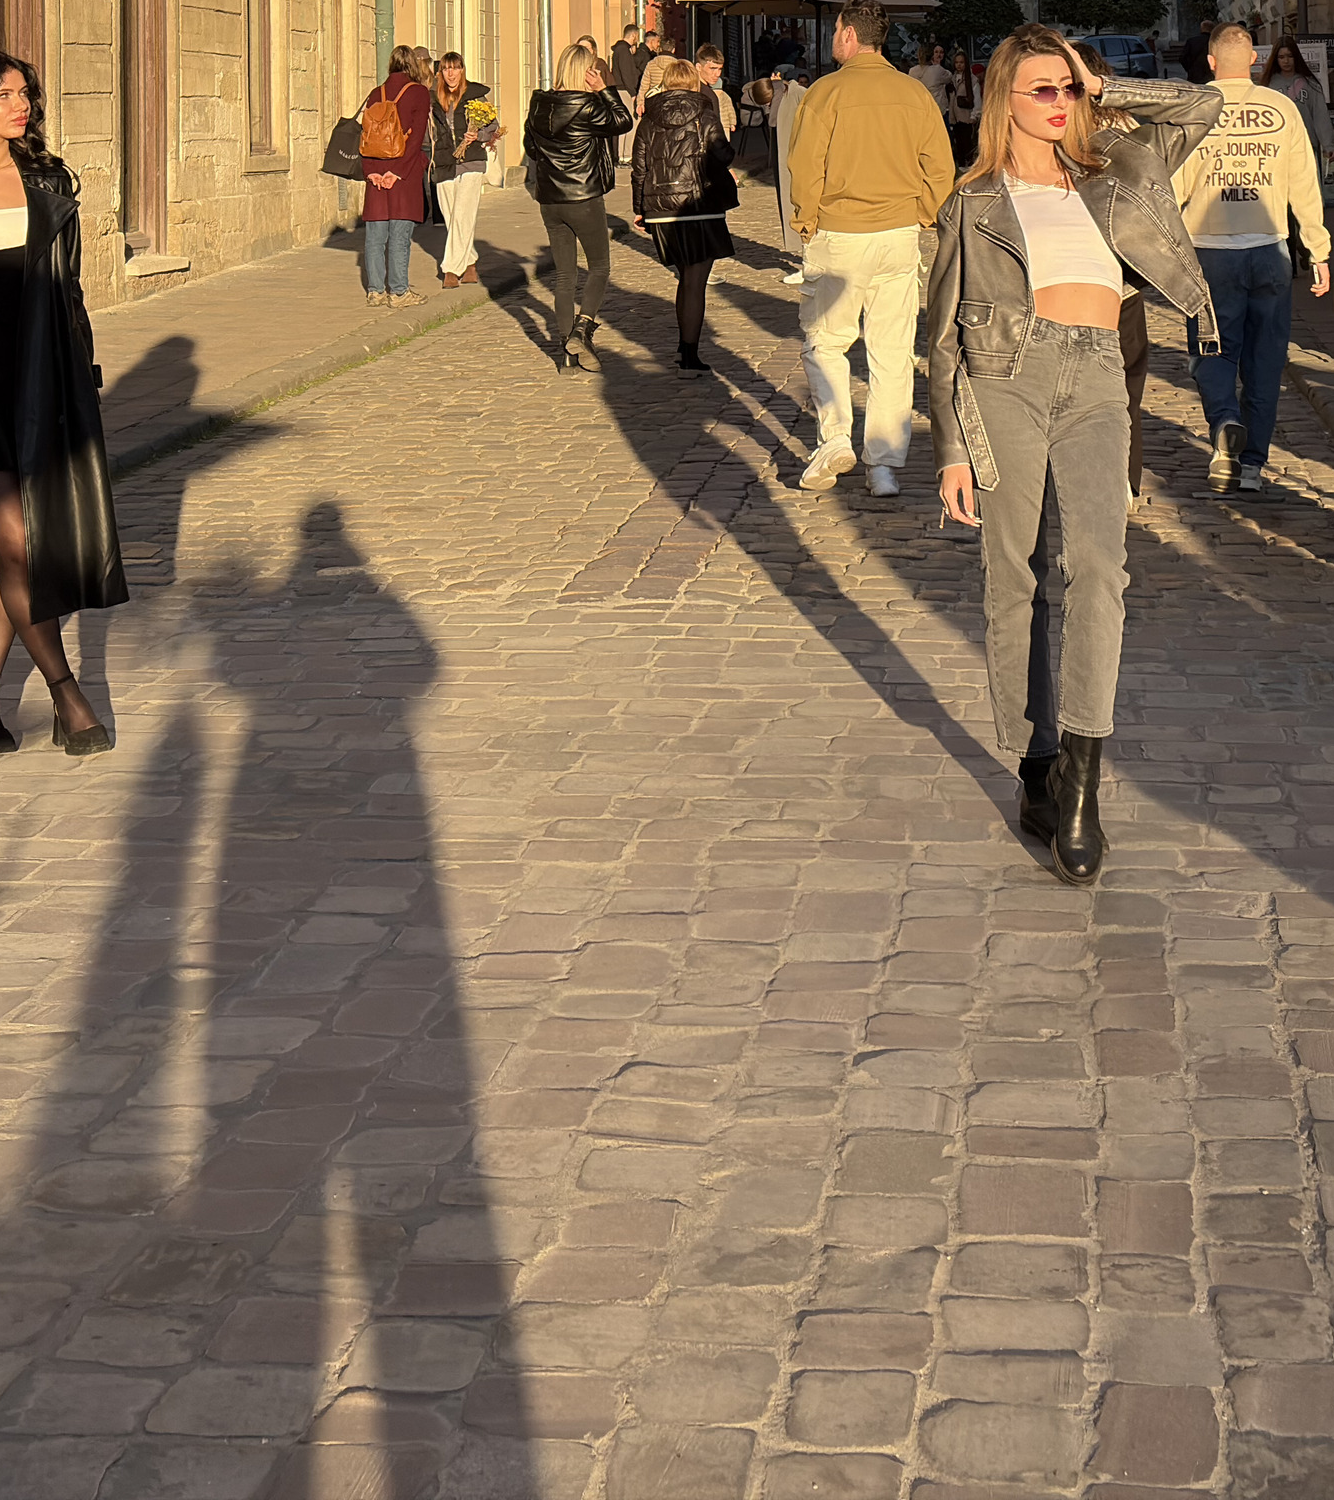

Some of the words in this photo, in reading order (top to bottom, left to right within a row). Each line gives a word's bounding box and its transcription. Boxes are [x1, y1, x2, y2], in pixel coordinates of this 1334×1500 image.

[1223, 142, 1280, 158] JOURNEY
[1211, 172, 1273, 187] THOUSAN
[1221, 187, 1260, 202] MILES
